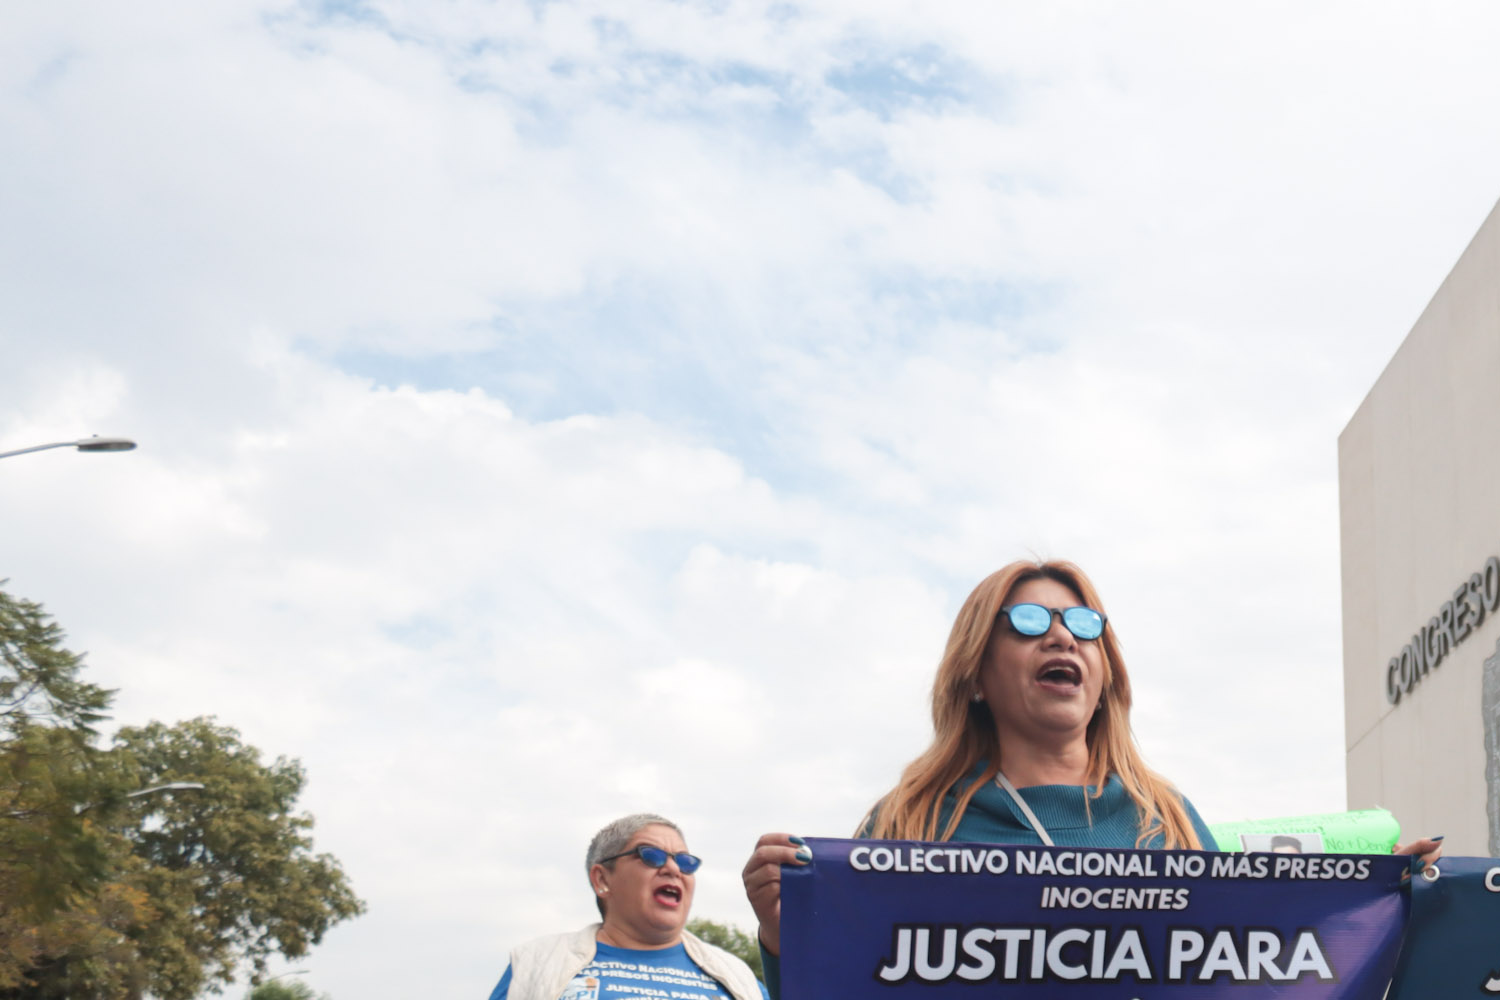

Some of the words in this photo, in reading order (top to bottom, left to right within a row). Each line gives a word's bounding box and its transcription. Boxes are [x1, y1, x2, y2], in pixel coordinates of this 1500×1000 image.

[850, 847, 1008, 874] COLECTIVO
[1016, 851, 1157, 877] NACIONAL
[1165, 854, 1206, 878] NO
[1211, 851, 1269, 878] MÁS
[1274, 856, 1371, 880] PRESOS
[1041, 887, 1189, 910] INOCENTES
[879, 928, 1152, 981] JUSTICIA
[1169, 930, 1333, 980] PARA
[605, 984, 670, 997] JUSTICIA
[671, 990, 710, 1000] PARA
